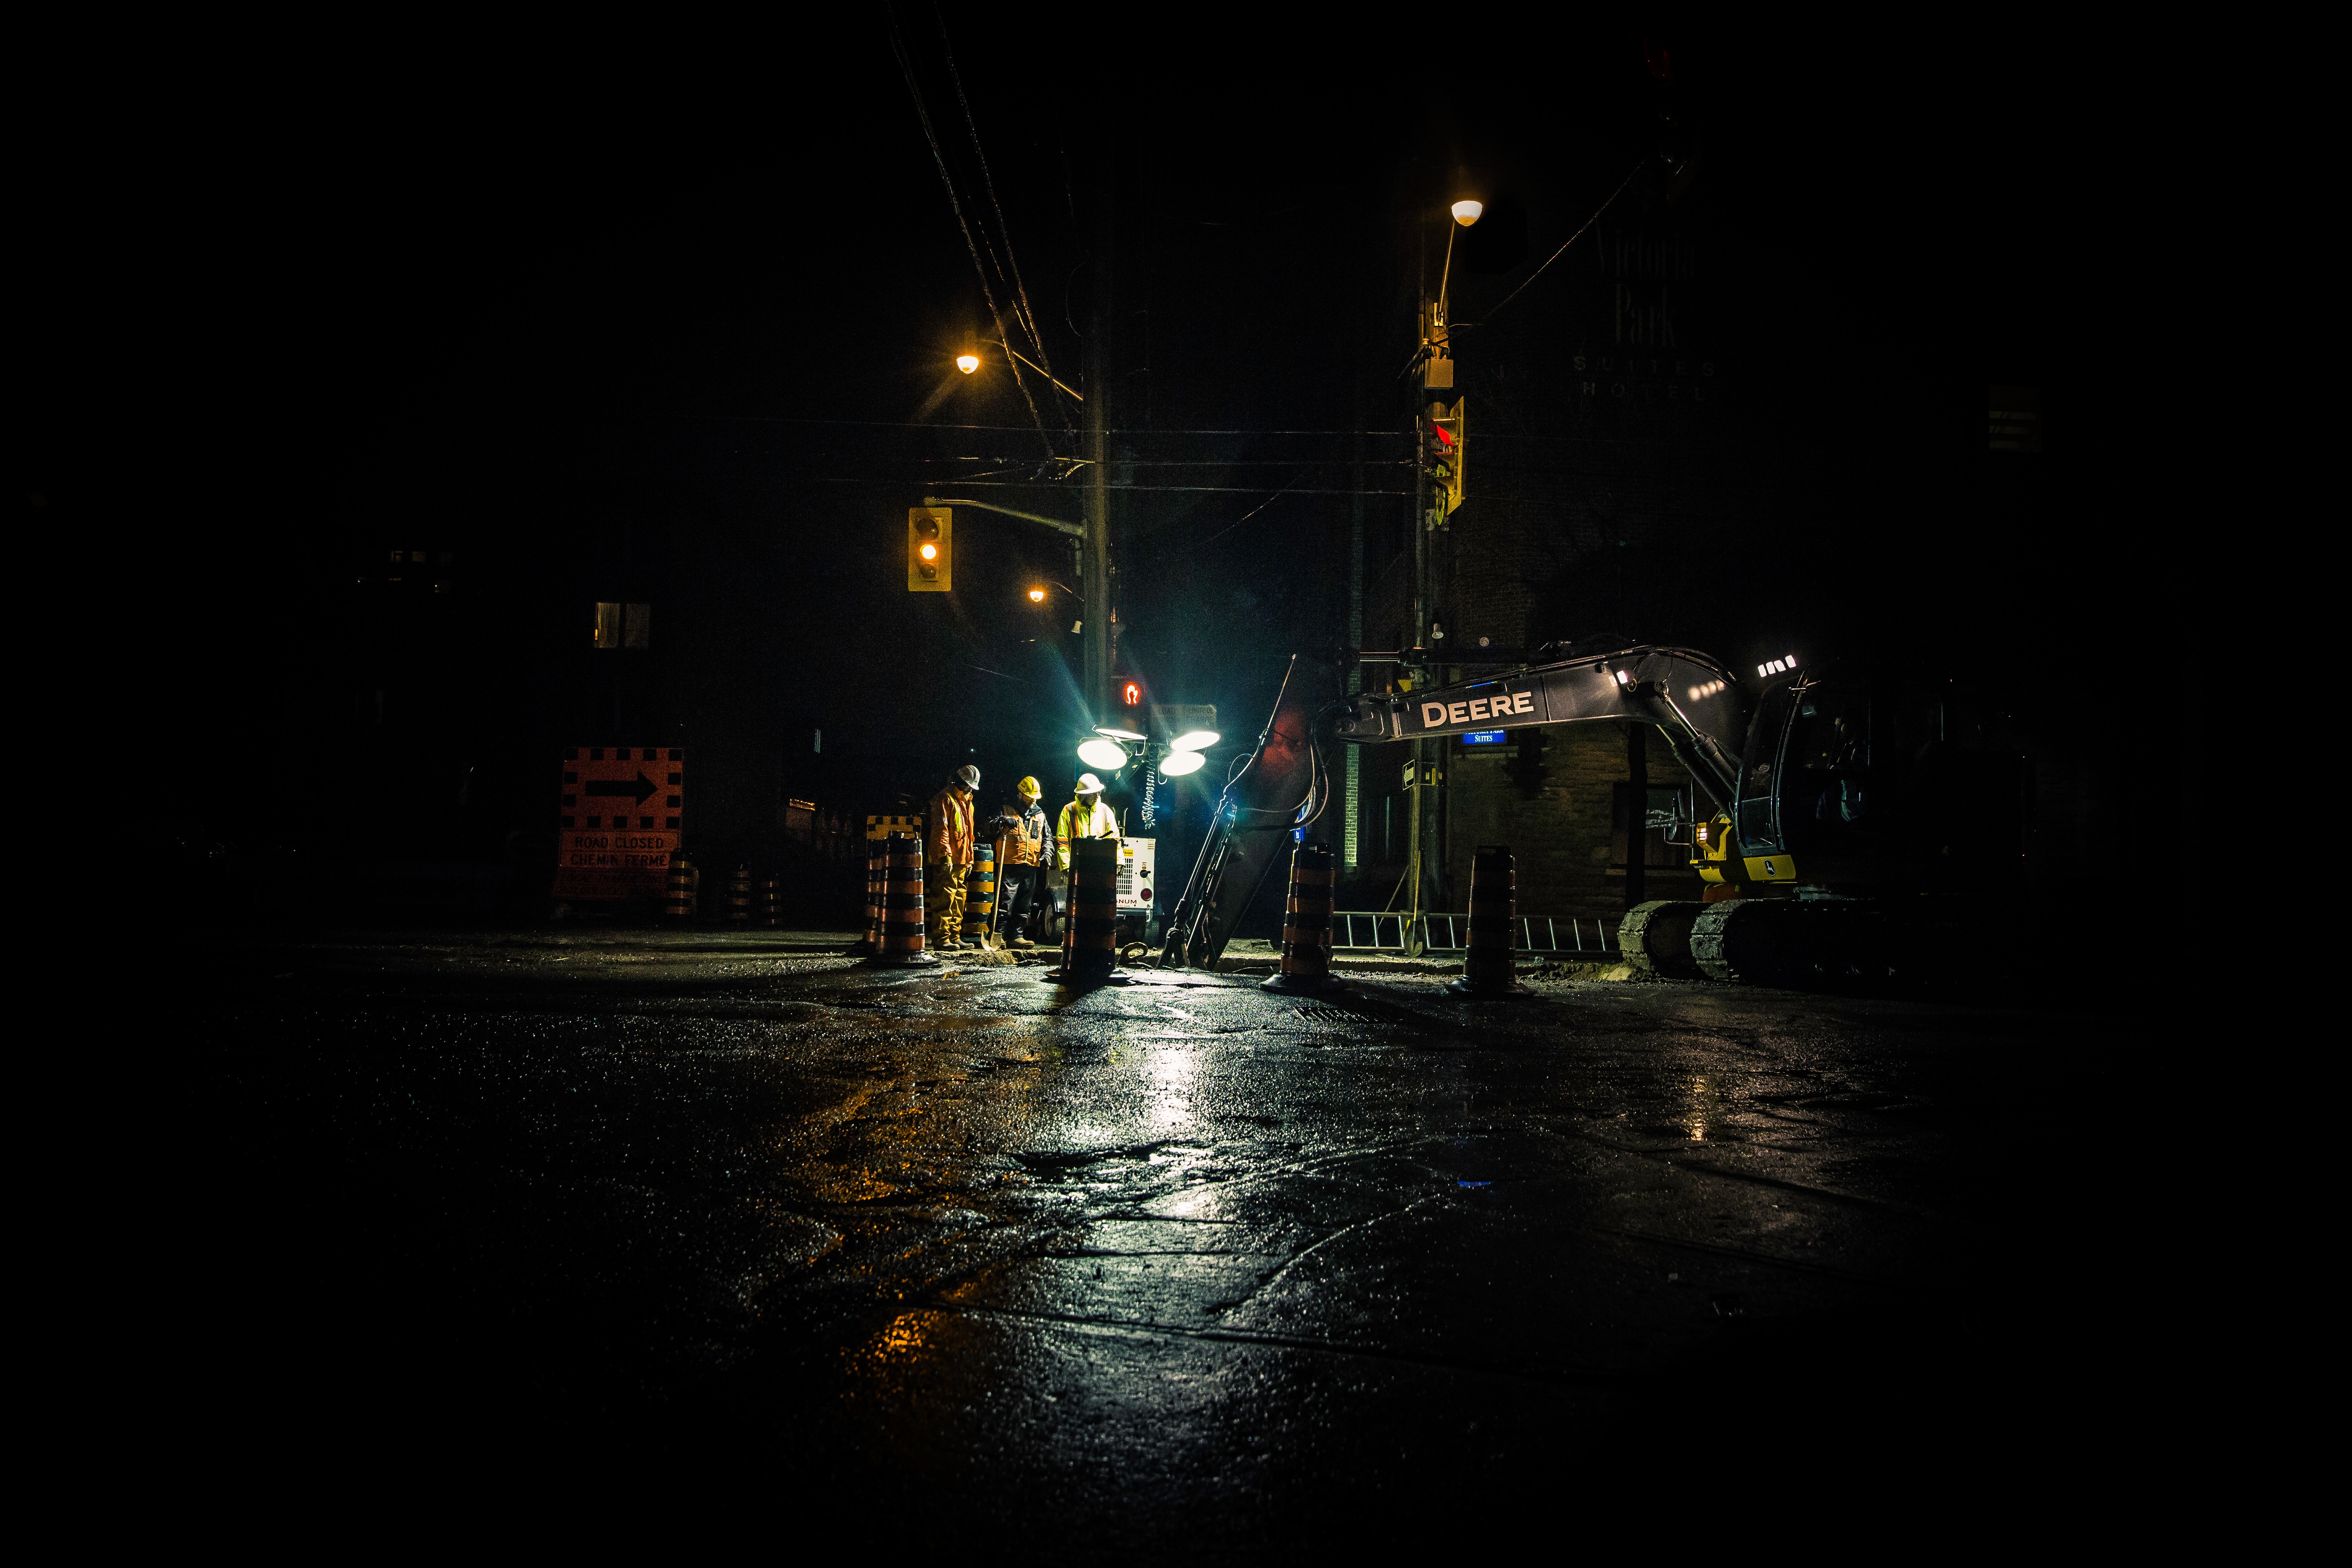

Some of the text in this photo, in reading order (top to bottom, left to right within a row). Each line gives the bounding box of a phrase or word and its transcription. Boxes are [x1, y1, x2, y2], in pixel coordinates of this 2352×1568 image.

[1615, 283, 1677, 347] Park
[1573, 355, 1714, 377] SUITES
[1583, 381, 1705, 401] HOTEL
[1421, 691, 1534, 728] DEERE
[575, 837, 664, 849] ROAD CLOSED
[571, 853, 667, 866] CHEMIN FERMÉ
